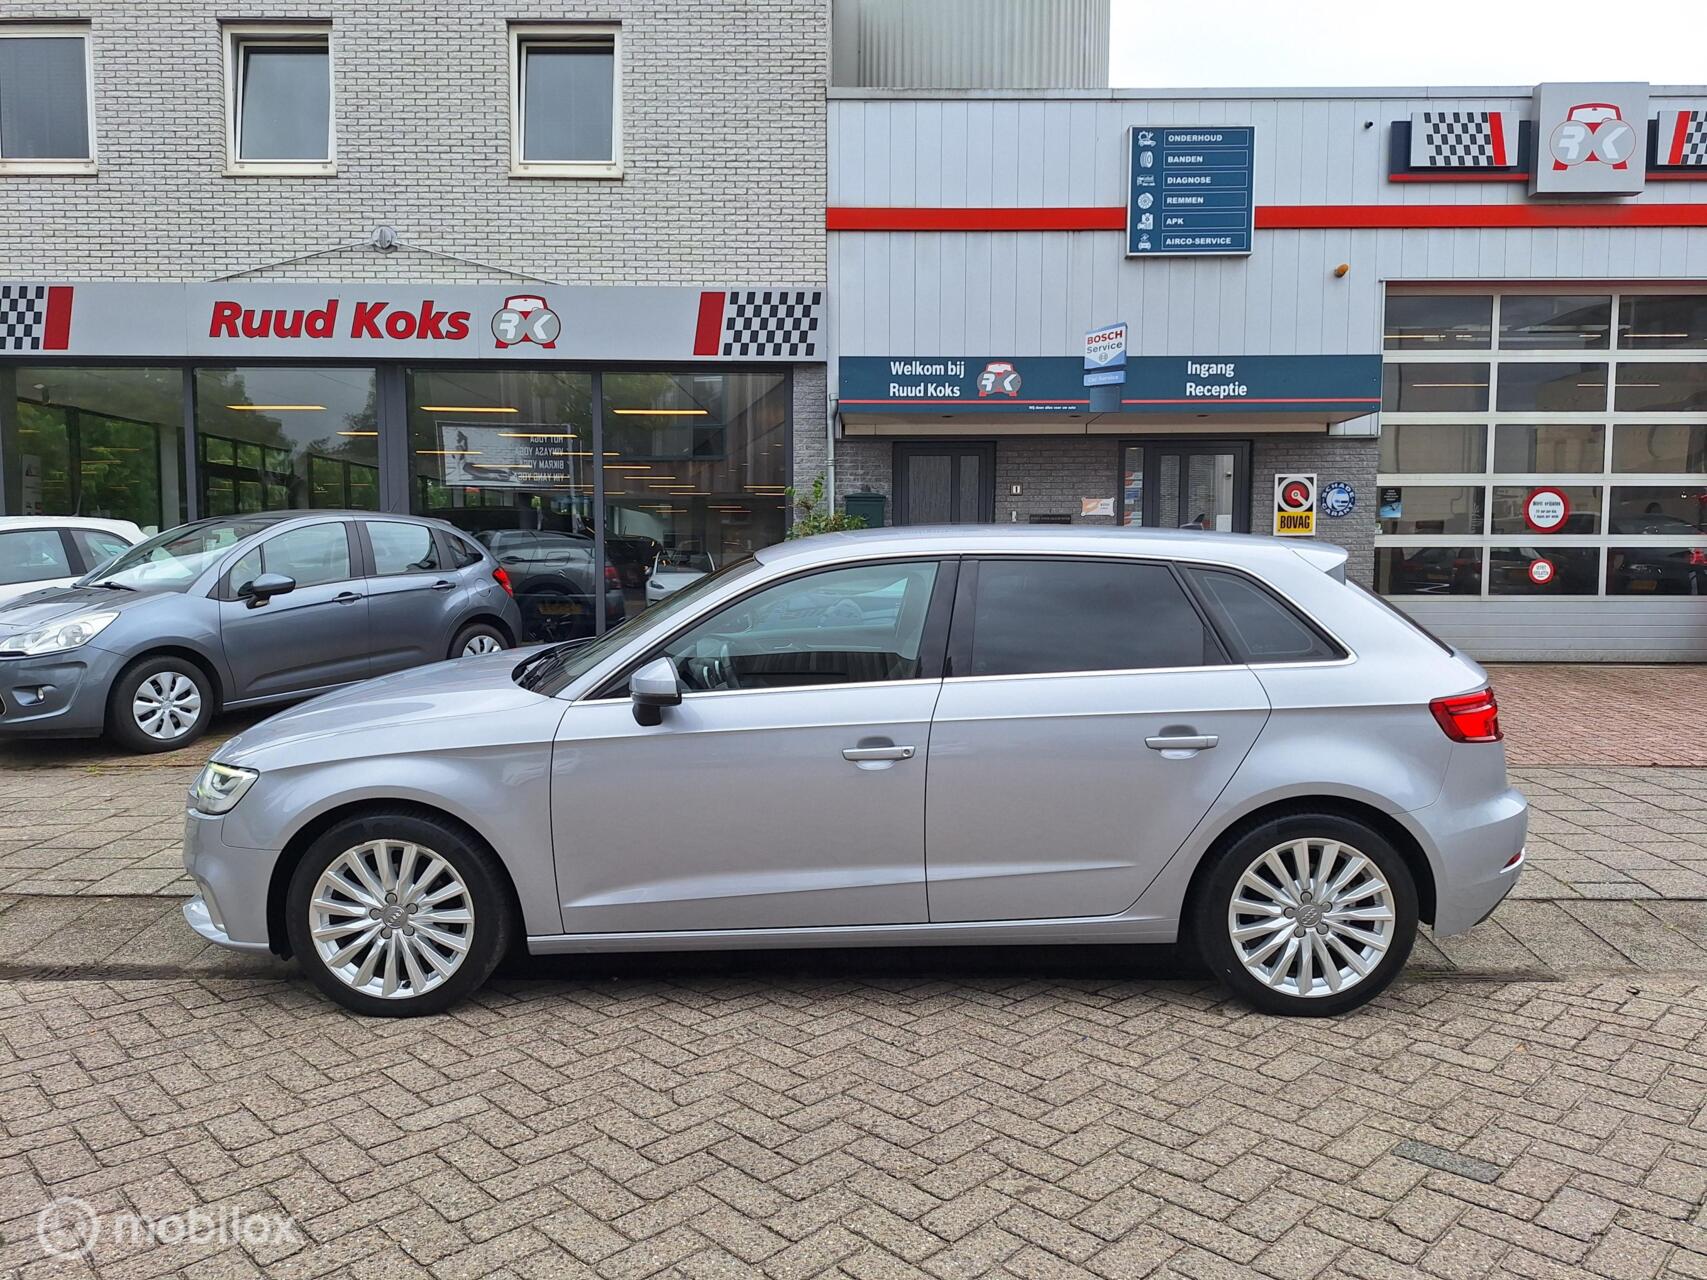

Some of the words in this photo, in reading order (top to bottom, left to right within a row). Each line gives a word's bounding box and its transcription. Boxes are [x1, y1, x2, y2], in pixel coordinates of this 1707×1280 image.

[1167, 134, 1223, 142] ONDERHOUD
[1167, 155, 1204, 163] BANDEN
[1166, 176, 1212, 184] DIAGNOSE
[1166, 196, 1204, 204] REMMEN
[1165, 217, 1184, 225] APK
[1165, 237, 1232, 245] AIRCO-SERVICE
[209, 299, 340, 338] Ruud
[350, 300, 471, 340] Koks
[1087, 329, 1123, 345] BOSCH
[1086, 341, 1123, 354] Service
[890, 361, 945, 376] Welkom
[947, 361, 965, 378] bij
[1187, 360, 1235, 378] Ingang
[889, 382, 926, 397] Ruud
[927, 382, 961, 397] Koks
[1185, 381, 1248, 399] Receptie
[1321, 483, 1355, 498] SCHADE
[1279, 515, 1311, 529] BOVAG
